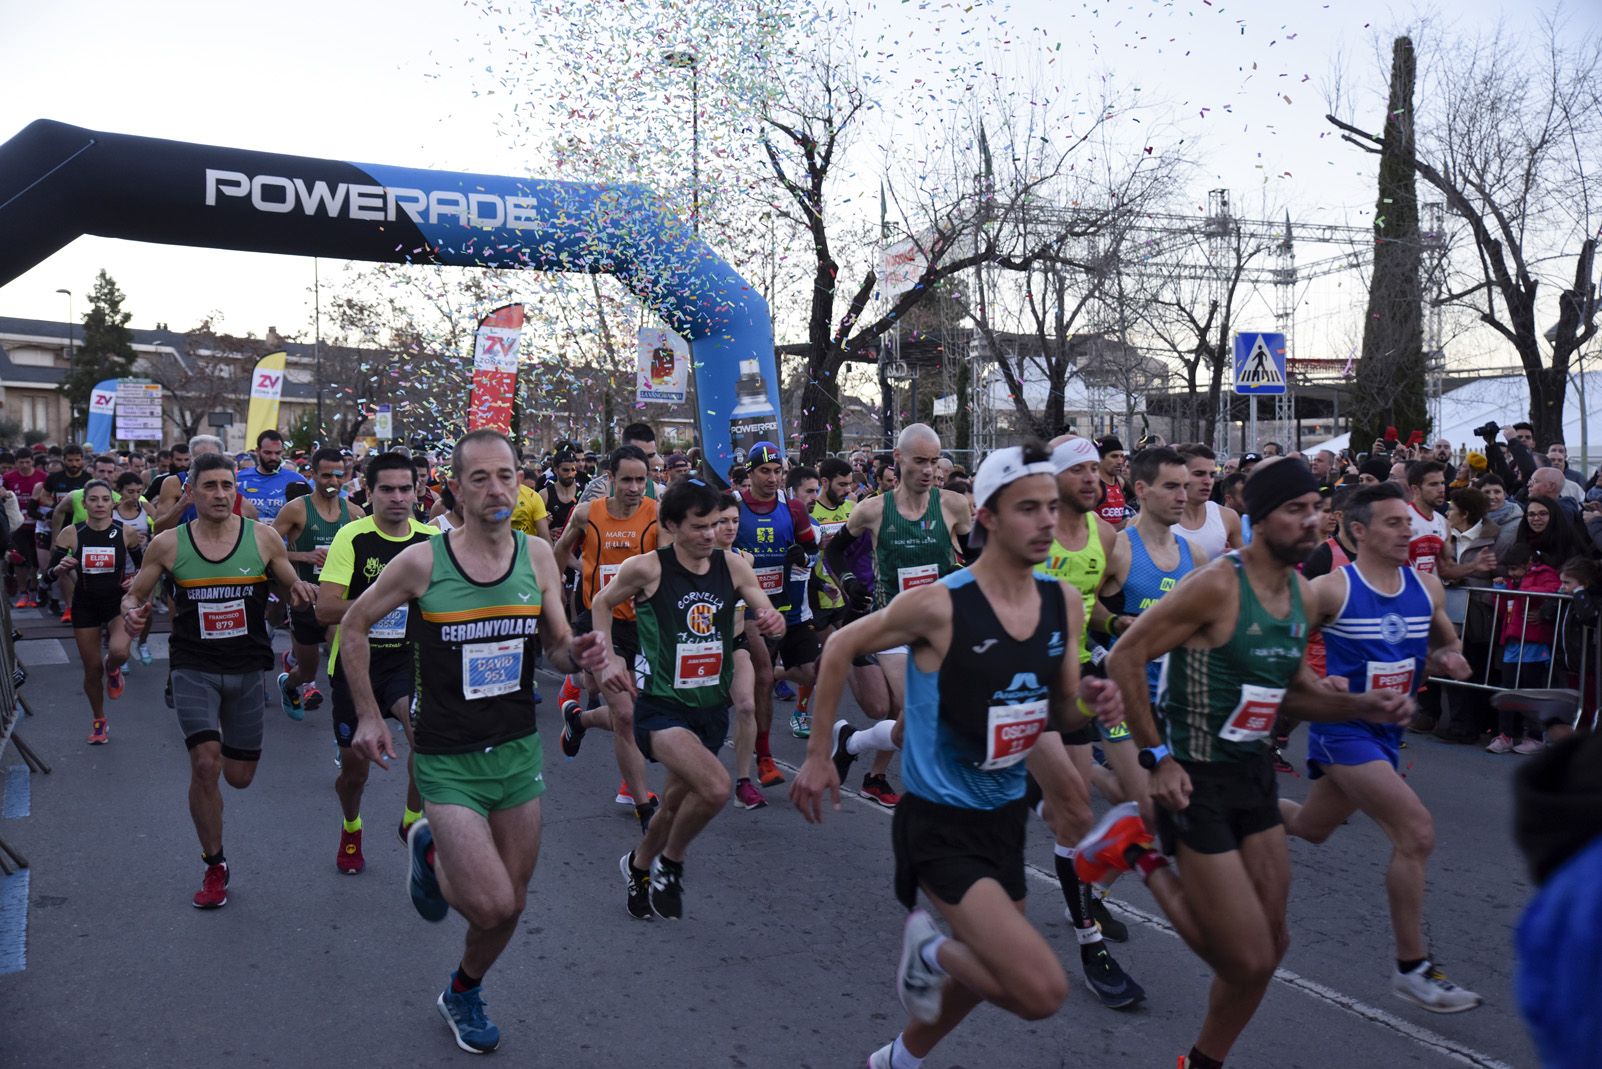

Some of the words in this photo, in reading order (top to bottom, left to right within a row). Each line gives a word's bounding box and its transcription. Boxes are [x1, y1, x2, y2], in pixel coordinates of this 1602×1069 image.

[205, 168, 538, 230] POWERADE
[257, 374, 280, 389] ZV
[95, 394, 112, 406] ZV
[731, 422, 777, 434] POWERADE
[267, 498, 283, 507] TRI
[187, 587, 241, 599] CERDANYOLA
[208, 612, 239, 620] FRANCISCO
[216, 620, 234, 630] 879
[441, 618, 523, 641] CERDANYOLA
[477, 656, 513, 671] DAVID
[698, 666, 705, 676] 6
